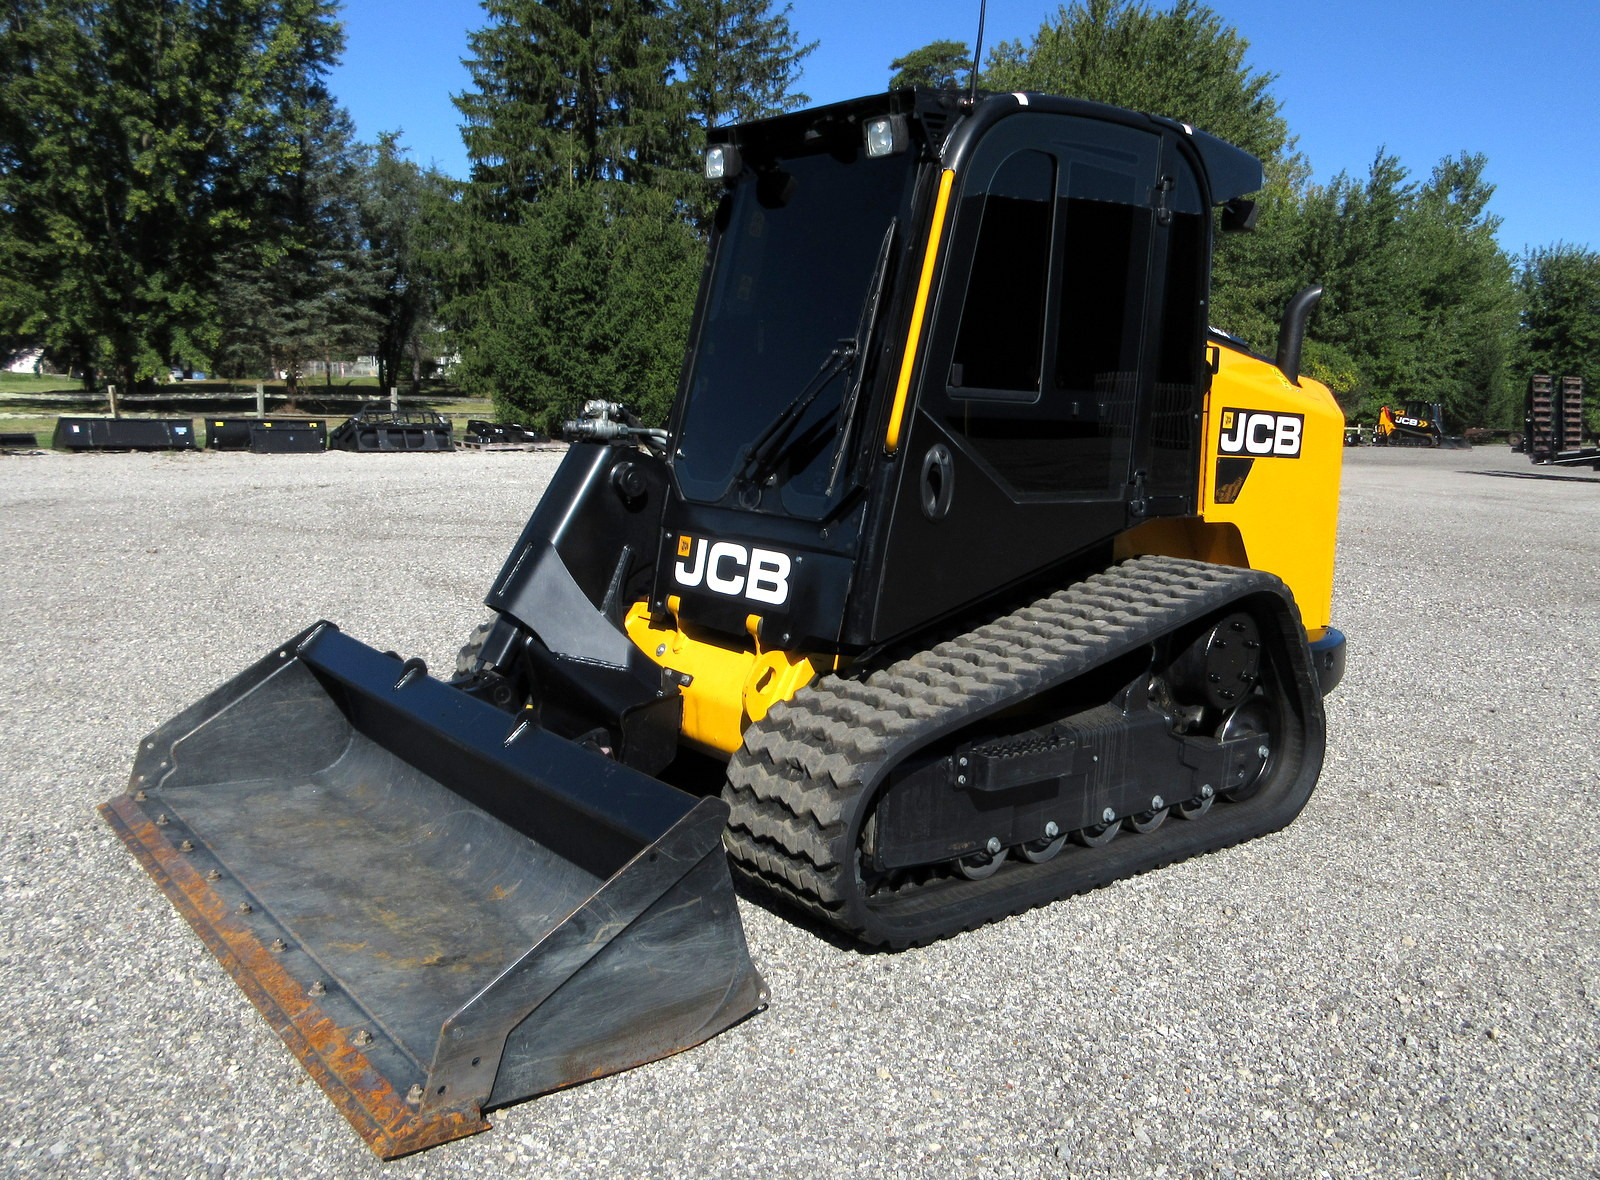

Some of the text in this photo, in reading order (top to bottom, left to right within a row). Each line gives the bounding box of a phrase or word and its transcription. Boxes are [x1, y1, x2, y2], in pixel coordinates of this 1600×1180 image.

[1220, 412, 1301, 455] JCB
[1395, 417, 1418, 426] JCB
[674, 538, 791, 605] JCB
